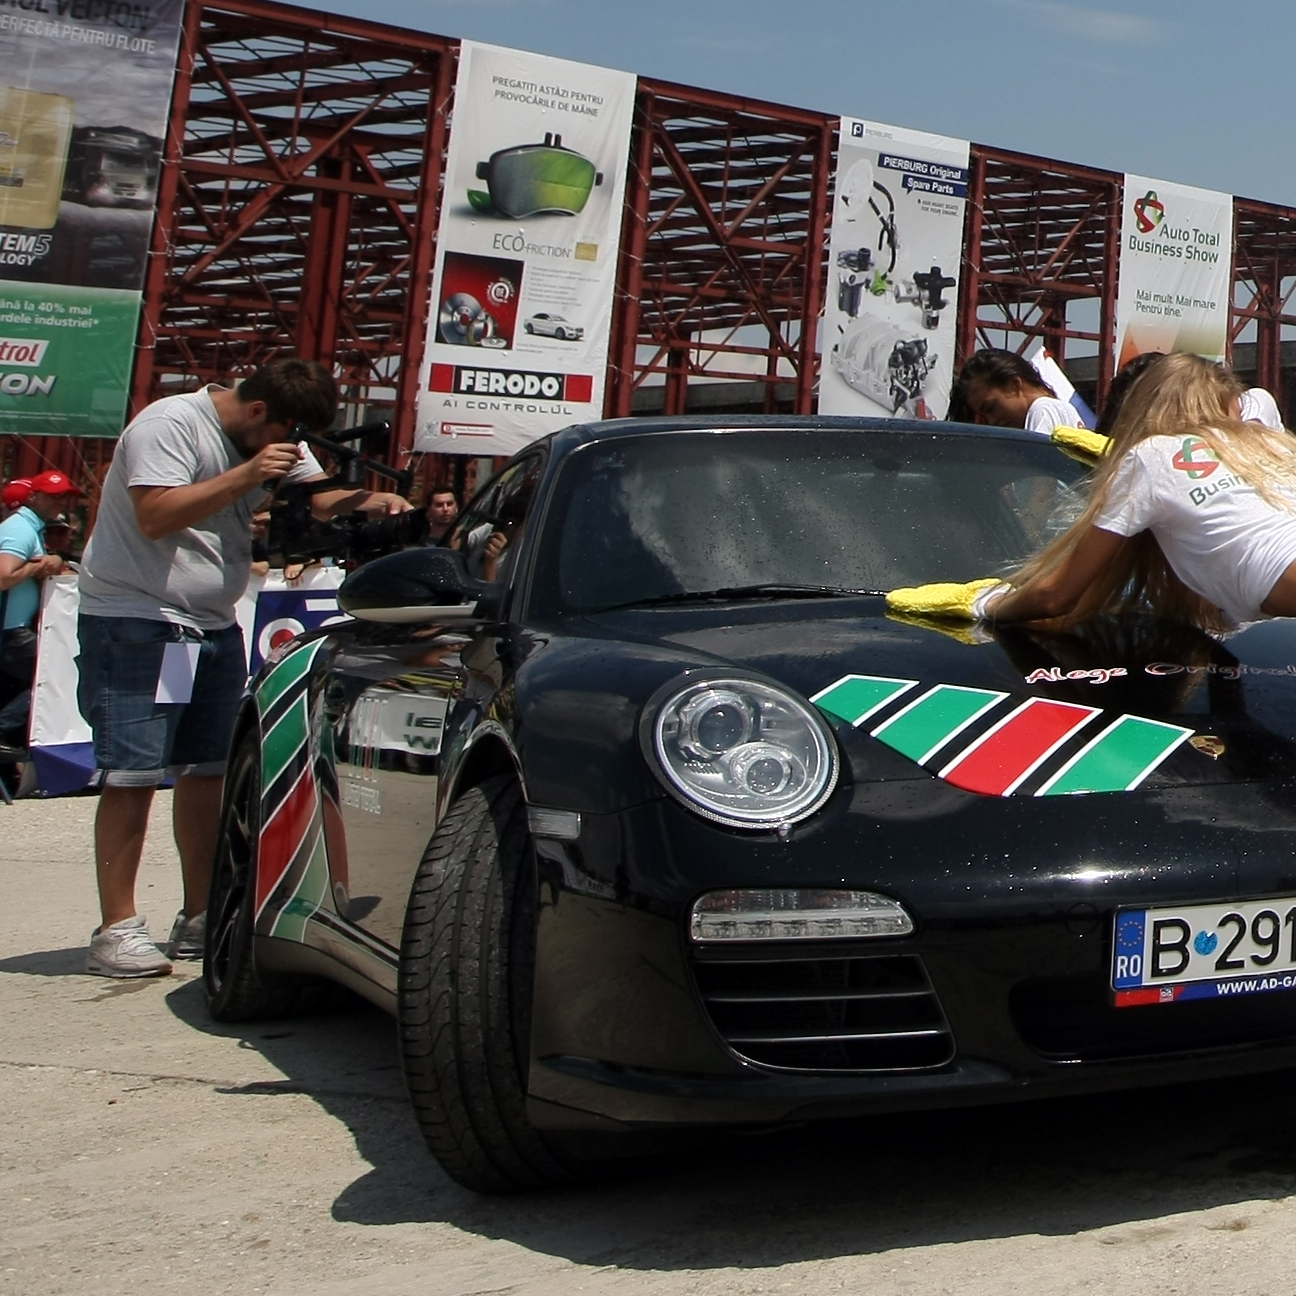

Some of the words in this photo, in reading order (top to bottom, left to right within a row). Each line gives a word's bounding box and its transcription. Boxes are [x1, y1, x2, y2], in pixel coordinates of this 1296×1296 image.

[60, 25, 115, 47] PENTRU
[116, 35, 157, 54] FLOTE
[558, 102, 571, 111] DE
[570, 91, 604, 105] PENTRU
[883, 156, 928, 173] PIERBURG
[930, 166, 961, 180] Original
[907, 177, 931, 190] Spare
[932, 183, 954, 194] Parts
[1159, 224, 1189, 242] Auto
[1192, 228, 1220, 246] Total
[1129, 235, 1182, 258] Business
[1185, 245, 1220, 263] Show
[24, 300, 34, 311] la
[38, 302, 65, 313] 40%
[69, 305, 92, 315] mai
[1136, 289, 1151, 300] Mai
[1175, 294, 1191, 306] Mai
[1193, 298, 1216, 310] mare
[1136, 301, 1162, 315] Pentru
[0, 373, 56, 395] ON
[460, 369, 559, 397] FERODO
[442, 399, 458, 408] AI
[466, 401, 573, 415] CONTROLUL
[1025, 667, 1128, 684] Alege
[1151, 917, 1191, 978] B
[1116, 954, 1141, 979] RO
